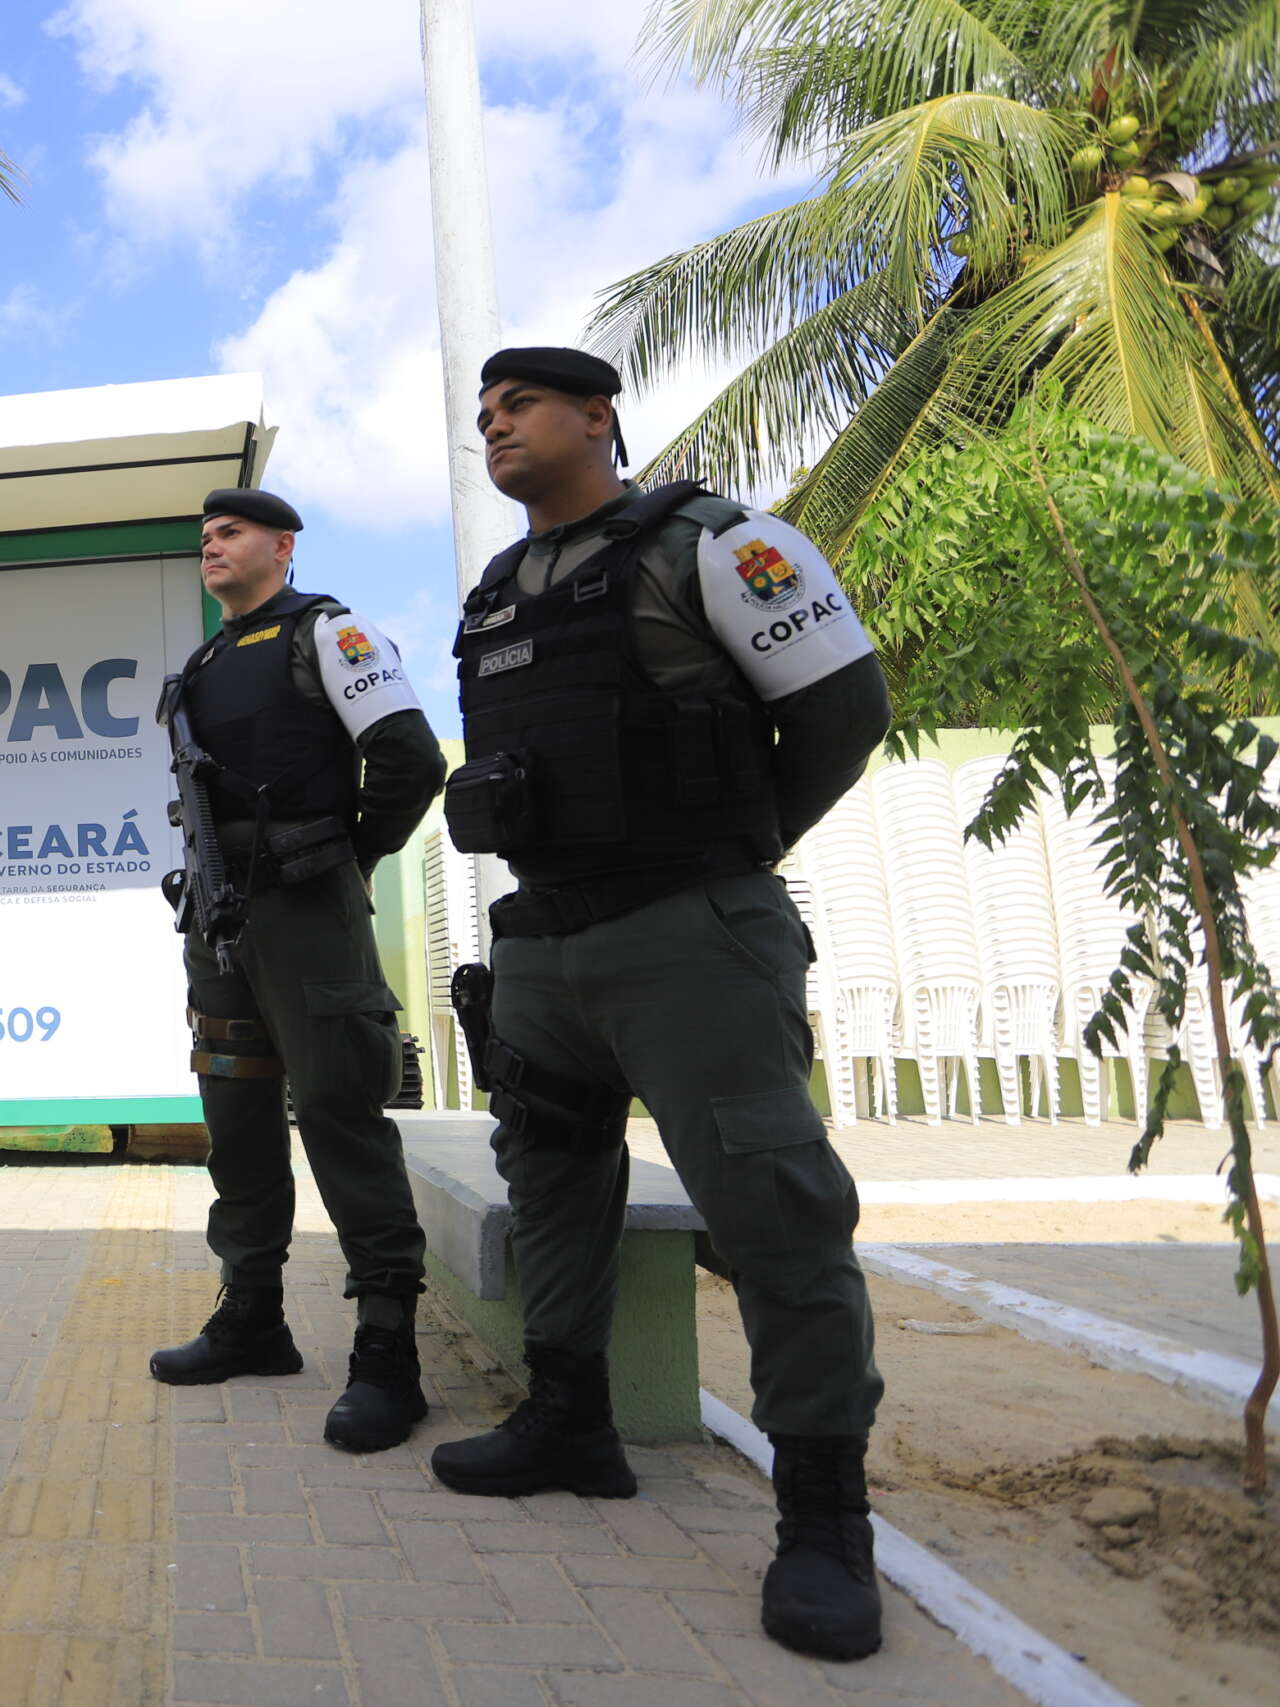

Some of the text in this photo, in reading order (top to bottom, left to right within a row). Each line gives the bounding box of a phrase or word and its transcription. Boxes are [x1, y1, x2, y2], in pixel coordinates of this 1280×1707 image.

[750, 592, 842, 652] COPAC
[481, 646, 530, 673] POLÍCIA
[344, 668, 403, 700] COPAC
[31, 750, 47, 763] ÀS
[50, 747, 142, 762] COMUNIDADES
[57, 863, 81, 875] DO
[86, 860, 151, 874] ESTADO
[31, 885, 44, 893] DA
[46, 883, 106, 893] SEGURANÇA
[23, 896, 60, 904] DEFESA
